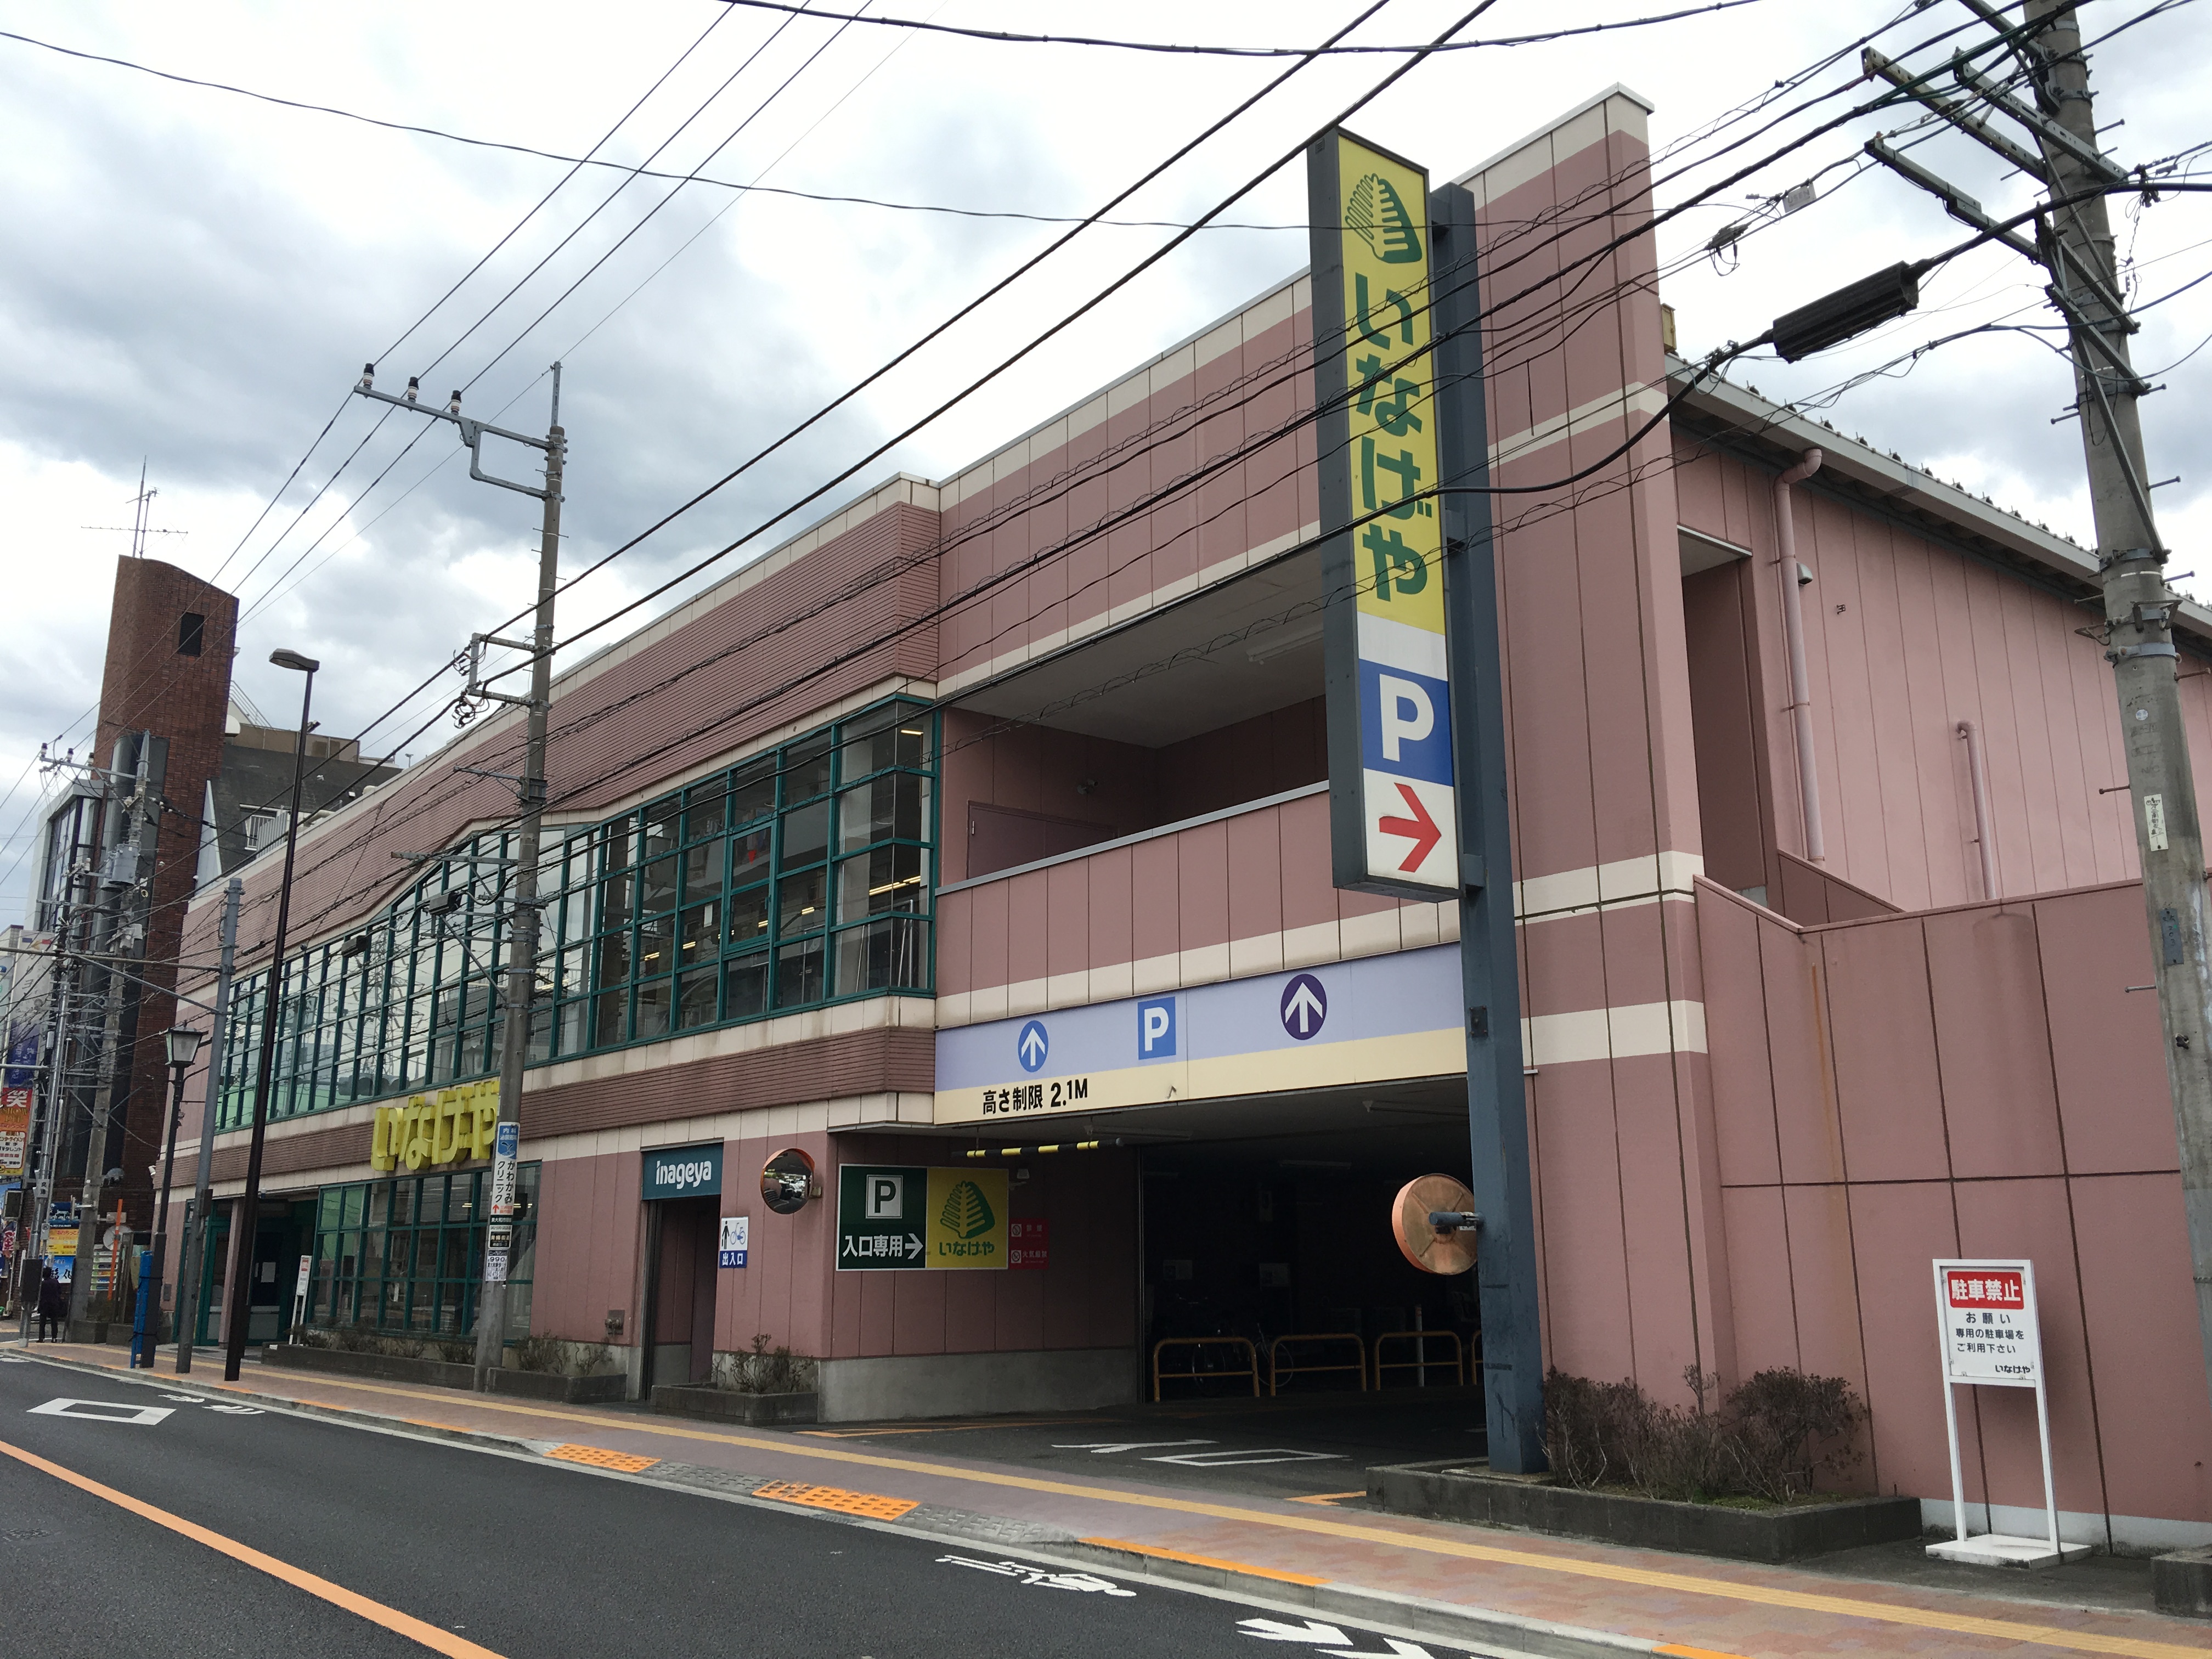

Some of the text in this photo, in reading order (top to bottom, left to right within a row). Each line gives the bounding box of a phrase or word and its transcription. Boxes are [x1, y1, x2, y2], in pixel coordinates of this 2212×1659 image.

[1355, 272, 1432, 602] いなげや
[1379, 673, 1434, 761] P
[1144, 1007, 1169, 1052] P
[983, 1078, 1088, 1115] 高さ制限 2.1M
[495, 1161, 505, 1203] クリニック
[504, 1161, 515, 1204] かわかみ
[656, 1160, 712, 1189] inageya
[874, 1180, 896, 1214] P
[722, 1252, 743, 1266] 出入口
[842, 1235, 903, 1257] 入口専用
[939, 1242, 995, 1256] いなげや
[1951, 1279, 2021, 1301] 駐車禁止
[1956, 1328, 2024, 1340] 専用の駐車場を
[1957, 1343, 2016, 1353] ご利用下さい
